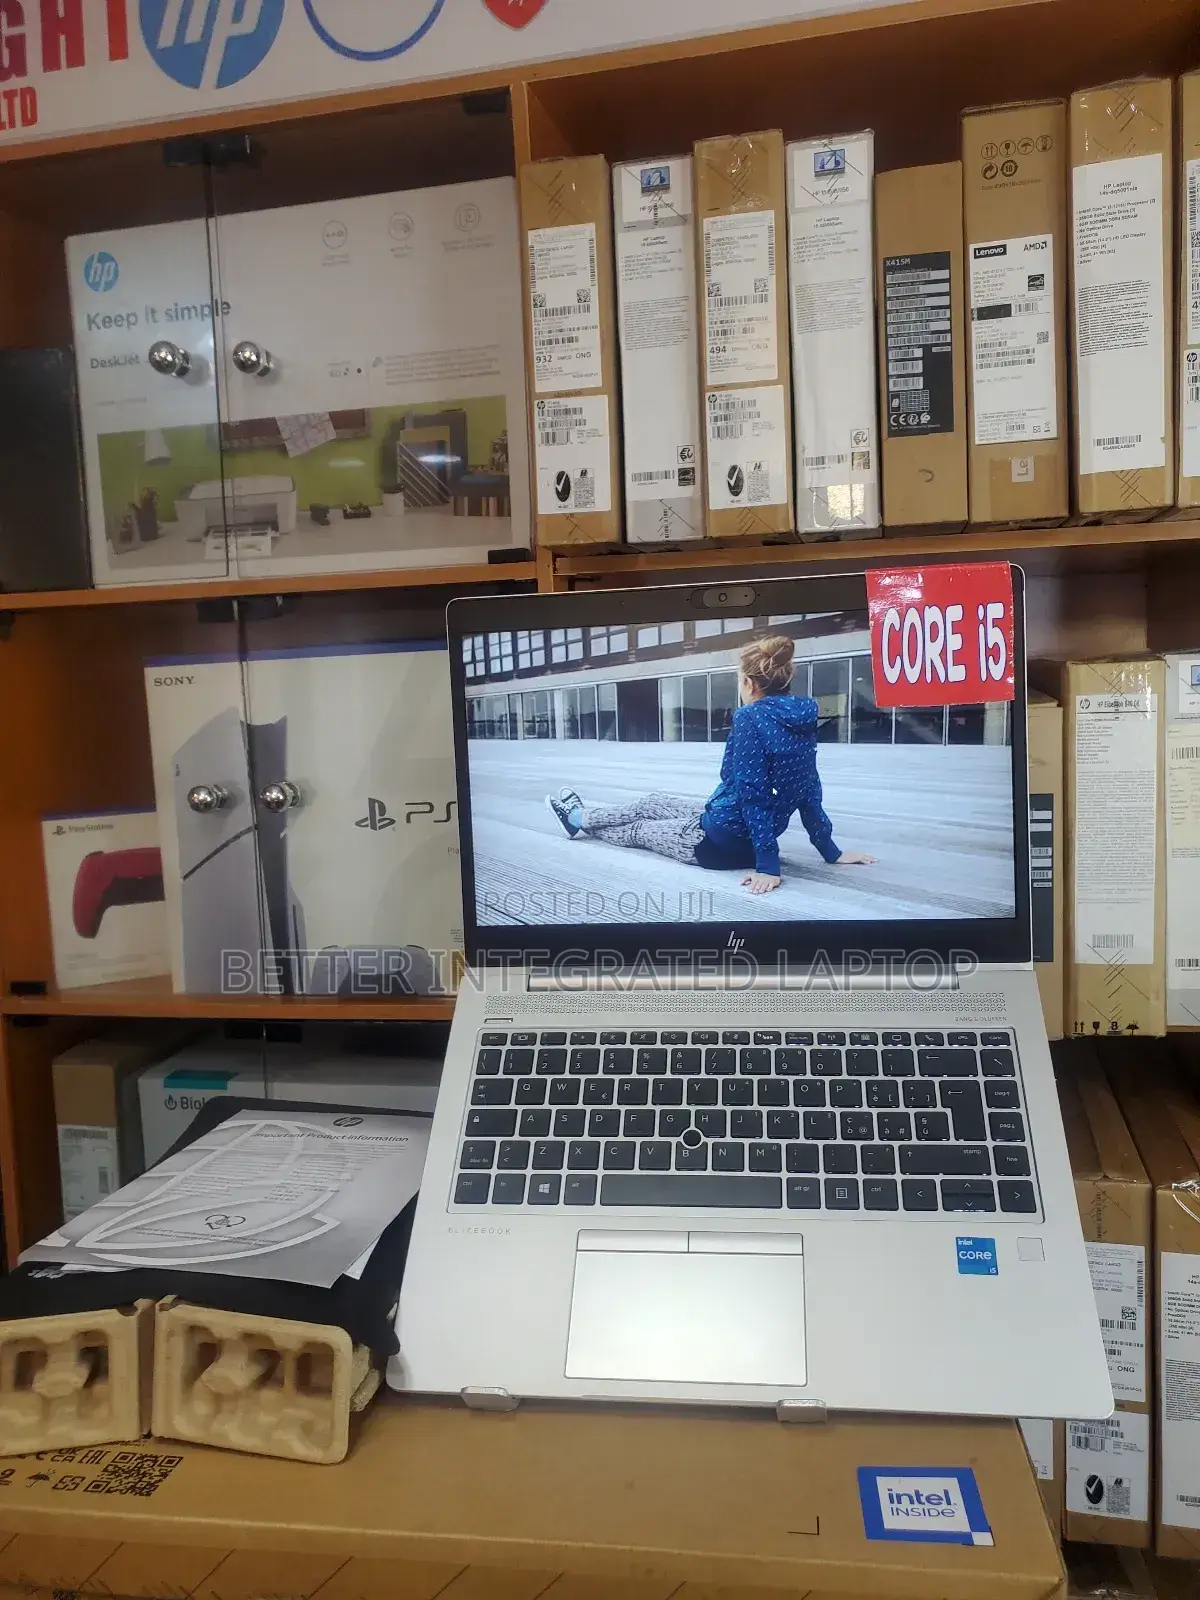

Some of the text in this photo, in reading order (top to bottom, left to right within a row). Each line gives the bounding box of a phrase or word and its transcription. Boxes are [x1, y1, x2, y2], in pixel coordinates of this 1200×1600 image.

[1112, 181, 1132, 189] Laptop
[975, 247, 1005, 257] Lenovo
[1023, 242, 1041, 252] AMD
[85, 252, 117, 292] hp
[86, 311, 138, 332] Keep
[164, 298, 231, 323] simple
[709, 345, 728, 354] 494
[535, 354, 553, 365] 932
[881, 601, 1007, 685] CORE i5
[153, 676, 195, 687] SONY
[746, 1062, 753, 1070] 8
[781, 1062, 788, 1070] 9
[522, 1083, 531, 1091] Q
[557, 1083, 568, 1091] W
[590, 1083, 596, 1091] E
[624, 1083, 631, 1091] R
[836, 1085, 843, 1093] P
[527, 1114, 535, 1122] A
[561, 1114, 568, 1122] S
[595, 1114, 603, 1122] D
[630, 1114, 637, 1122] F
[774, 1116, 781, 1124] K
[810, 1117, 816, 1125] L
[253, 1132, 409, 1143] Important Product Information
[539, 1147, 546, 1155] Z
[575, 1147, 582, 1155] X
[610, 1147, 618, 1155] C
[647, 1147, 654, 1155] V
[448, 1226, 512, 1236] ELITEBOOK
[957, 1238, 973, 1246] intel
[1117, 1365, 1135, 1373] ONG
